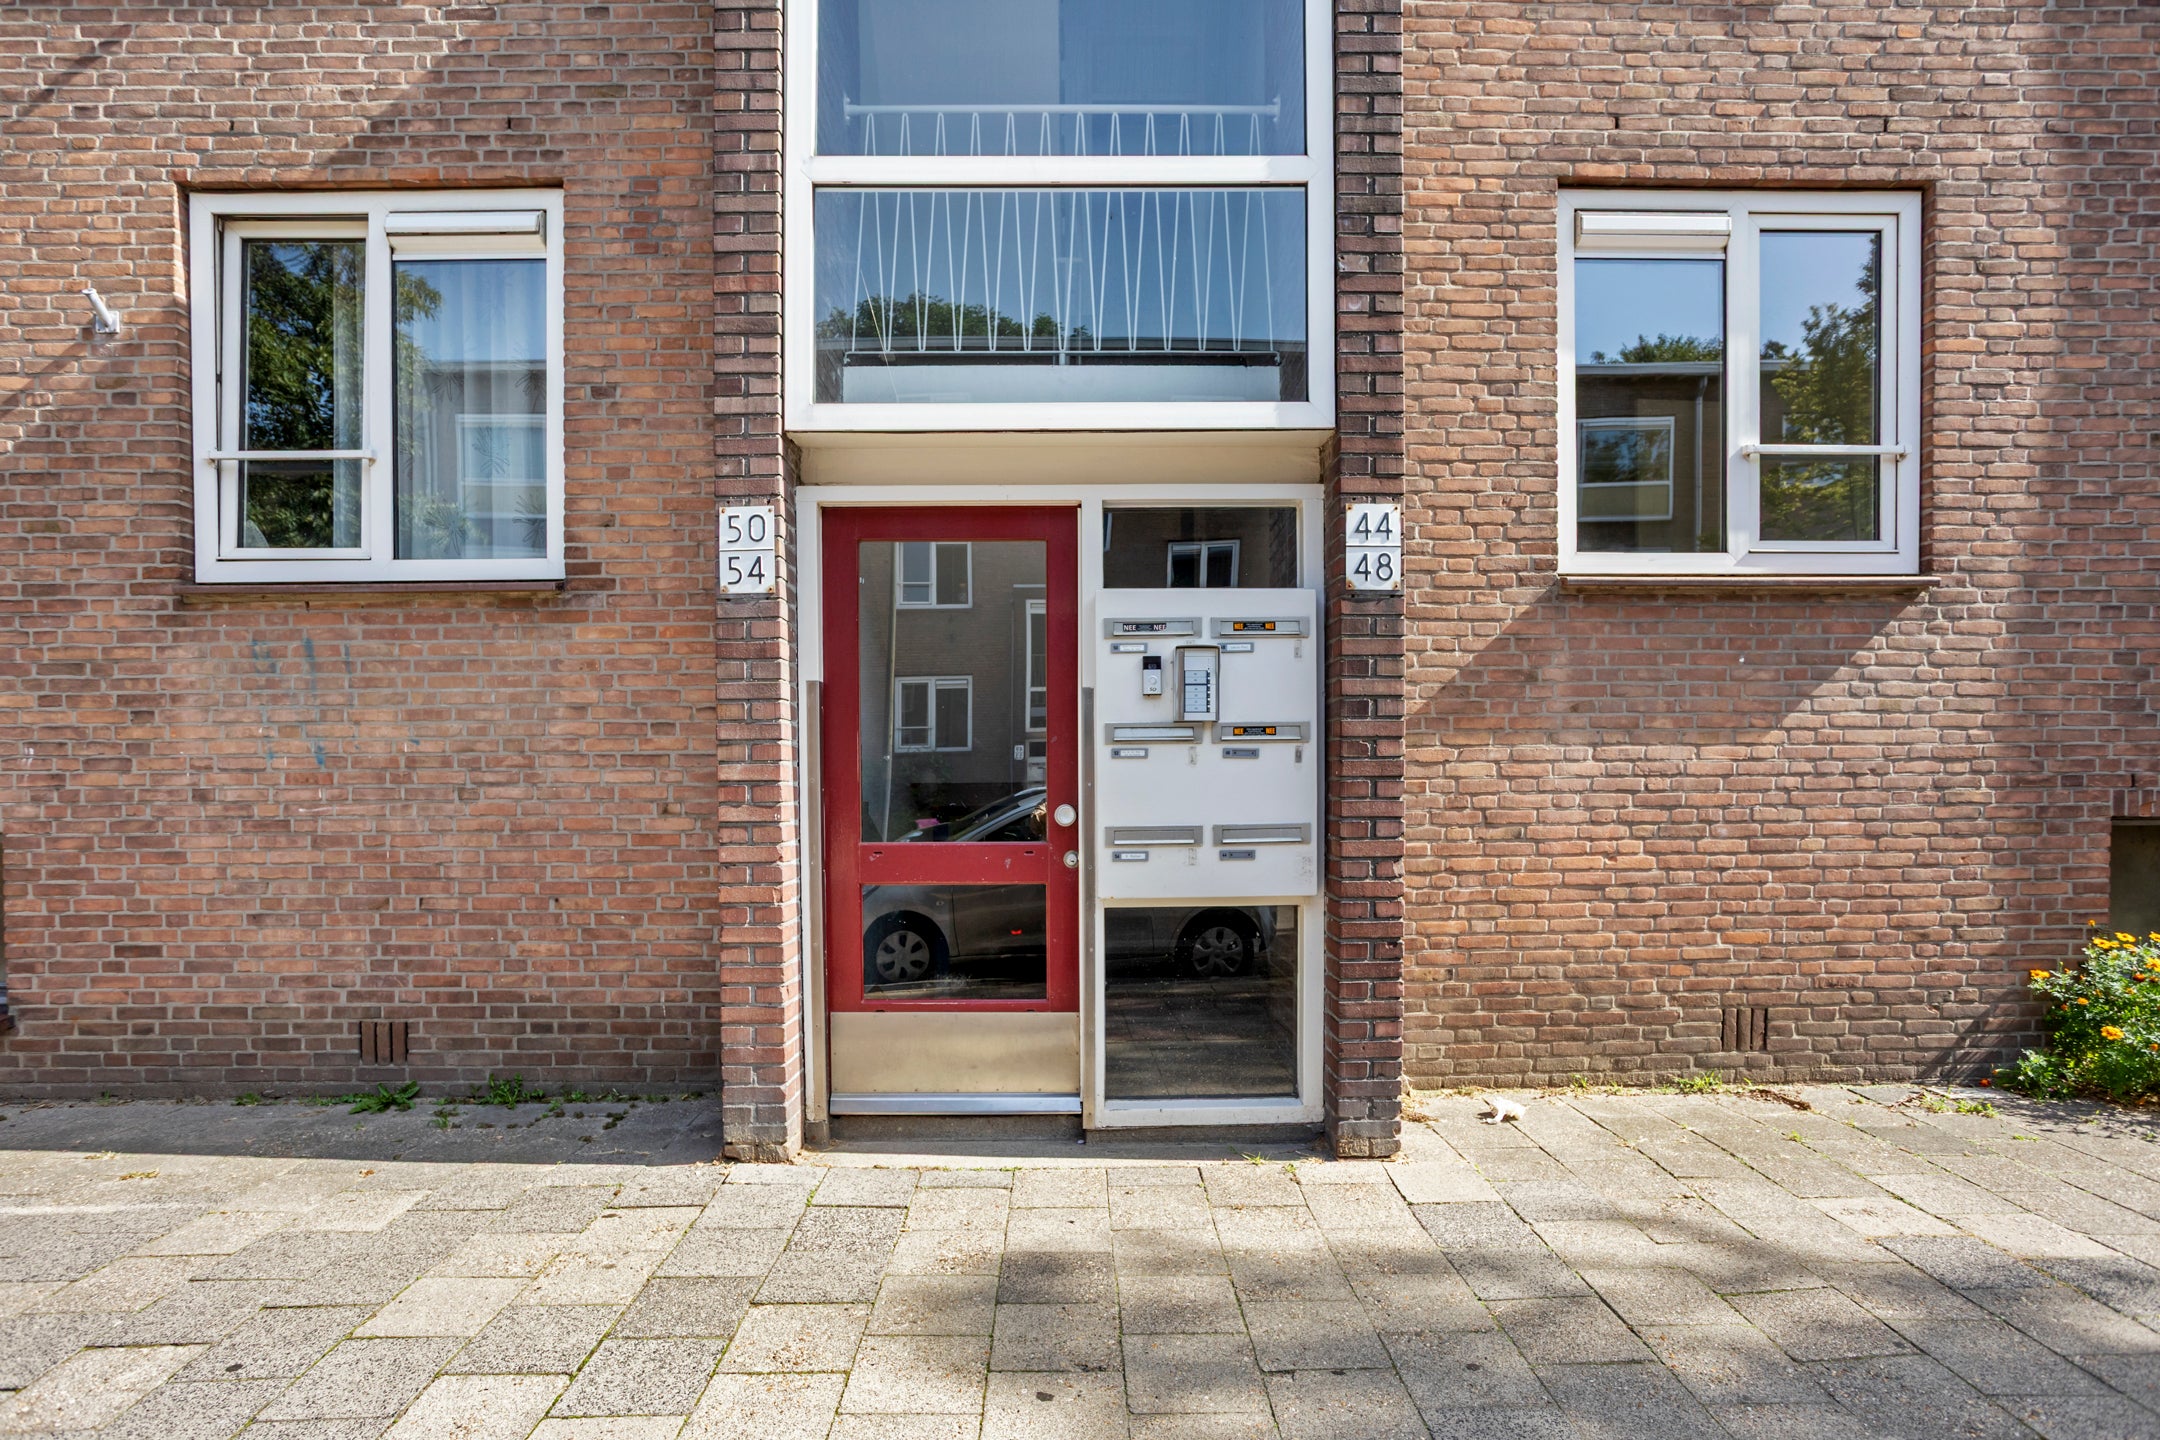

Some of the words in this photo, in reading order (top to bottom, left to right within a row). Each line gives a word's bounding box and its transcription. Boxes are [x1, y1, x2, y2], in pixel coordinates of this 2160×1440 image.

[727, 514, 766, 543] 50
[1354, 512, 1393, 540] 44
[728, 556, 765, 585] 54
[1353, 553, 1393, 581] 48
[1234, 622, 1244, 630] NEE
[1265, 622, 1275, 630] NEE
[1234, 727, 1244, 735] NEE
[1265, 727, 1275, 735] NEE
